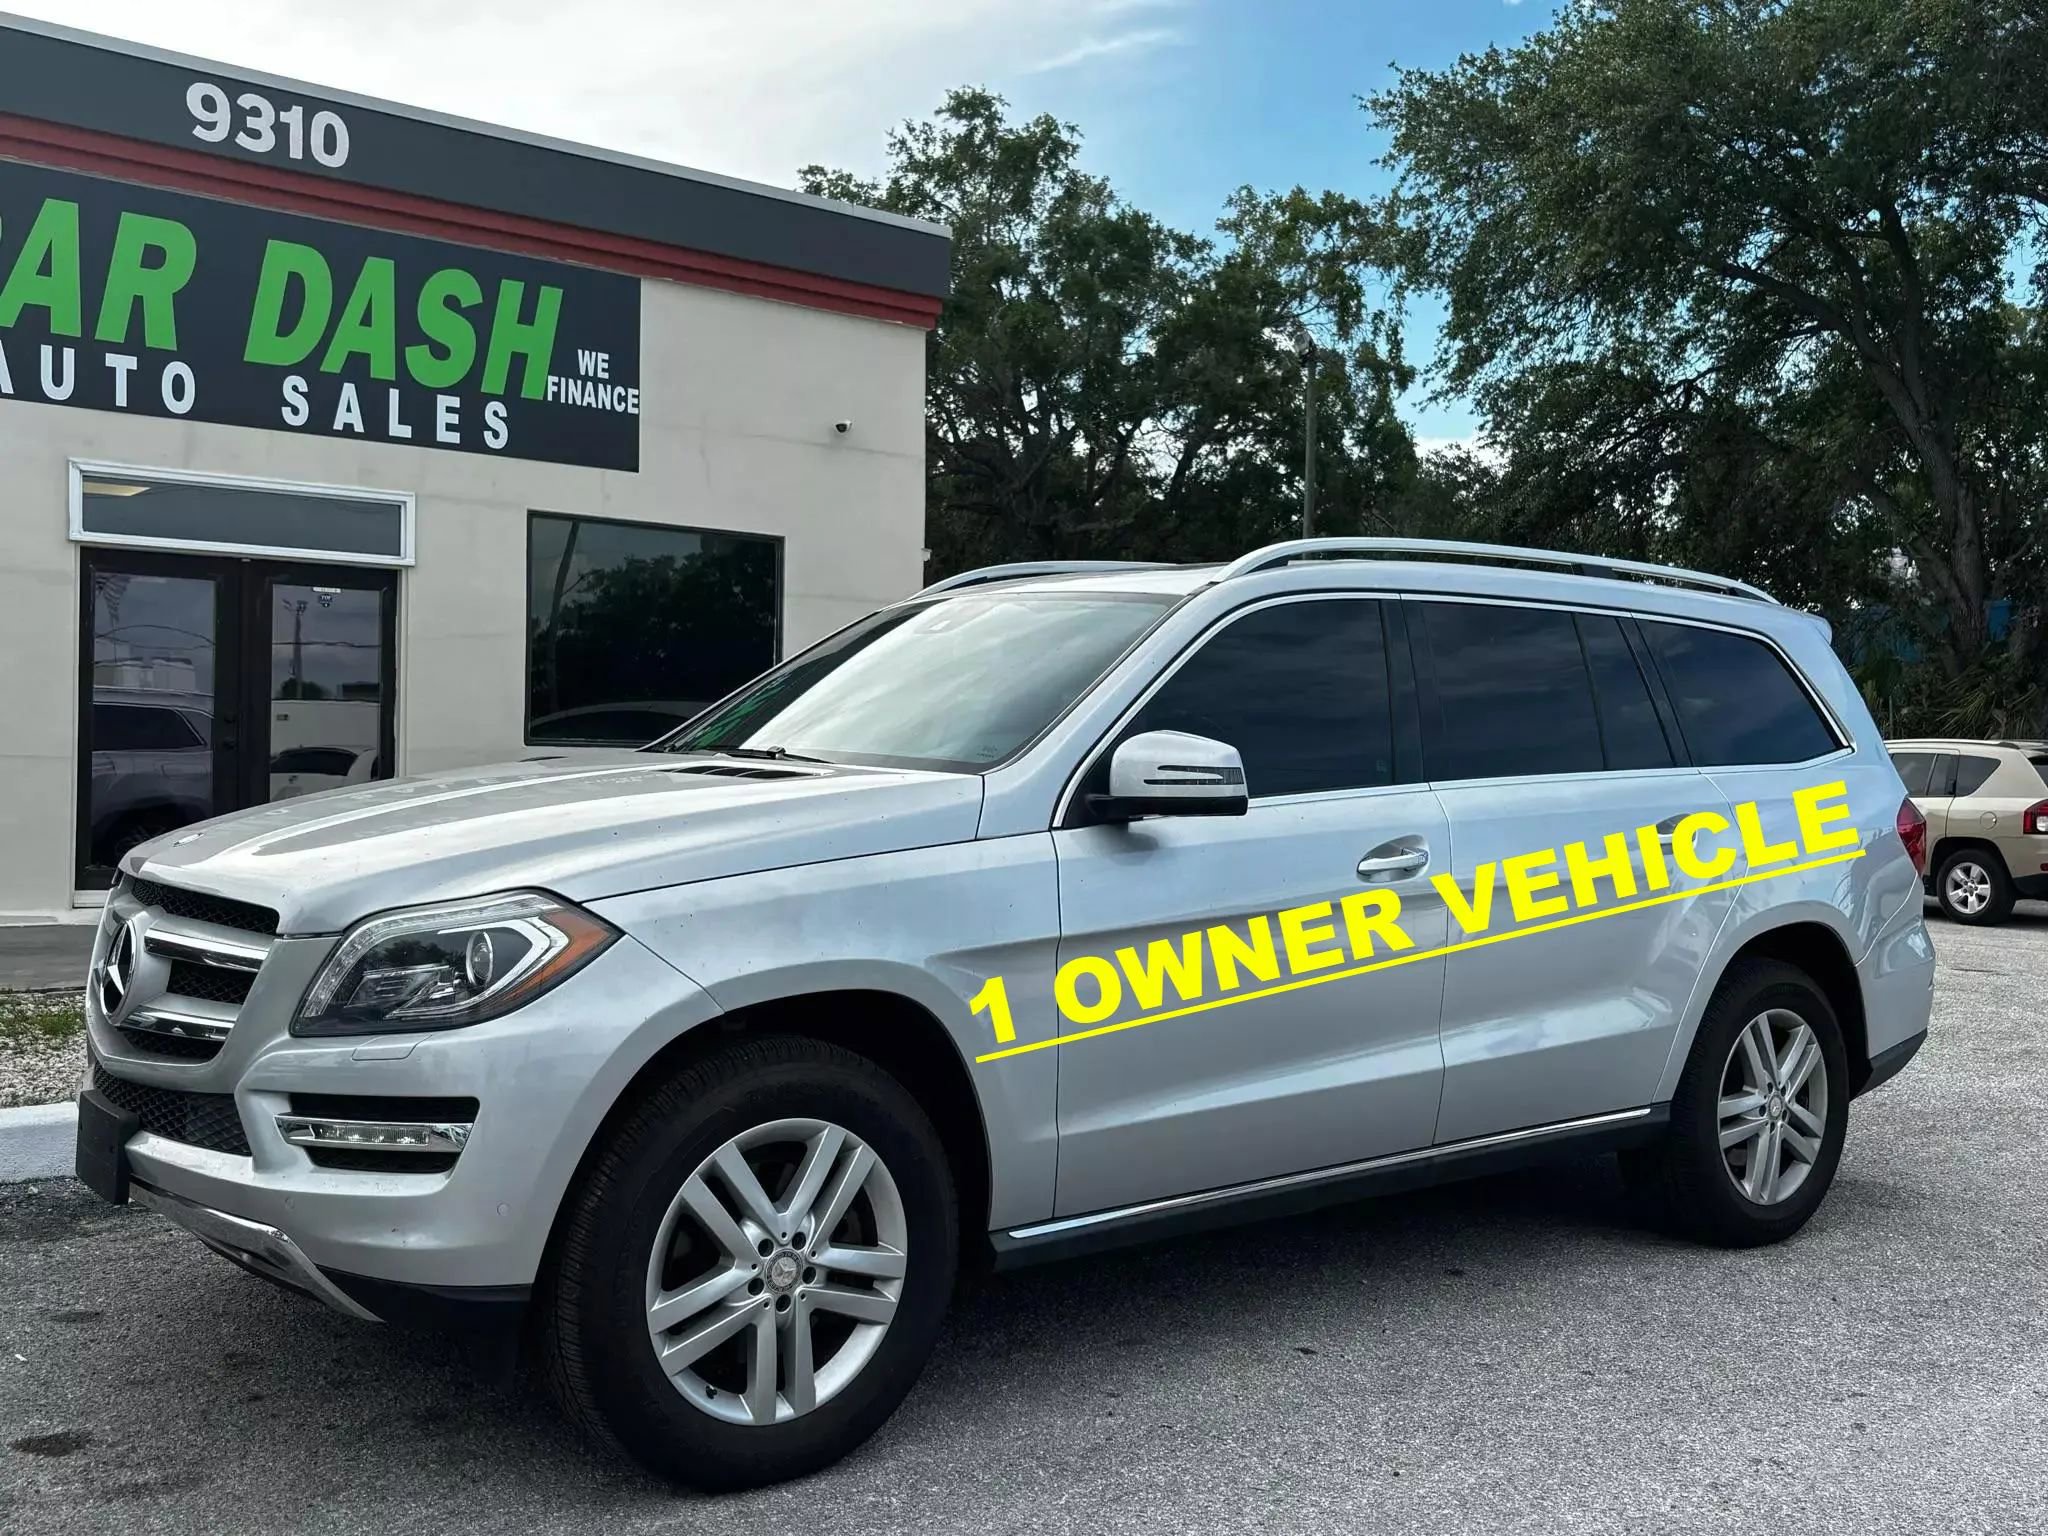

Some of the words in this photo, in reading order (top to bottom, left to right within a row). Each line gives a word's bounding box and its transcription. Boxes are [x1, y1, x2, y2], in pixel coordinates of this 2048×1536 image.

[186, 82, 350, 168] 9310
[0, 198, 197, 351] AR
[243, 239, 564, 400] DASH
[547, 375, 639, 415] FINANCE
[577, 349, 609, 380] WE
[281, 375, 509, 450] SALES
